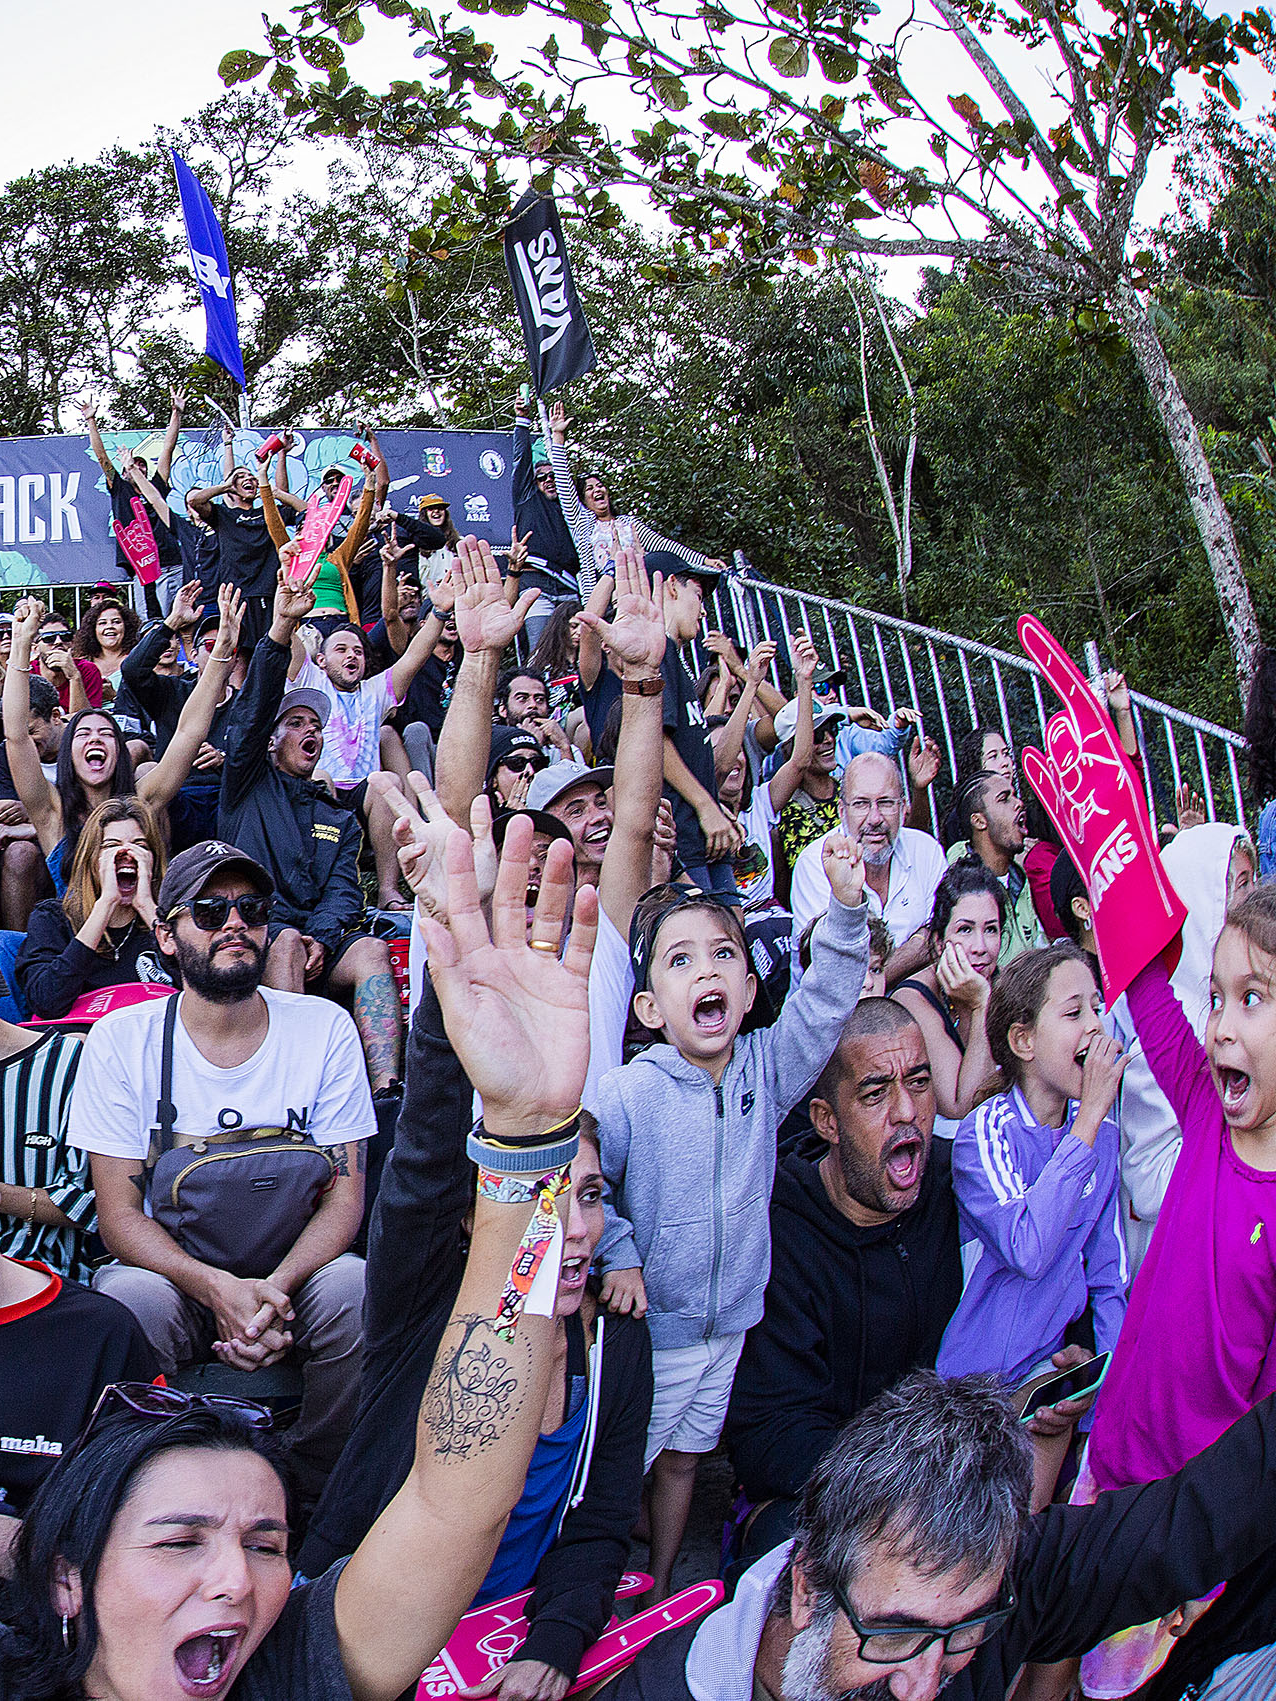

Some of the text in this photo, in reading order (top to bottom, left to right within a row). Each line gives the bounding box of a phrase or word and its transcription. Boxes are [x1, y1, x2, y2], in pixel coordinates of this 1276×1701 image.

[514, 229, 572, 355] VANS
[85, 989, 117, 1013] VANS
[25, 1134, 53, 1147] HIGH
[516, 1253, 536, 1276] STU
[0, 1434, 63, 1456] maha
